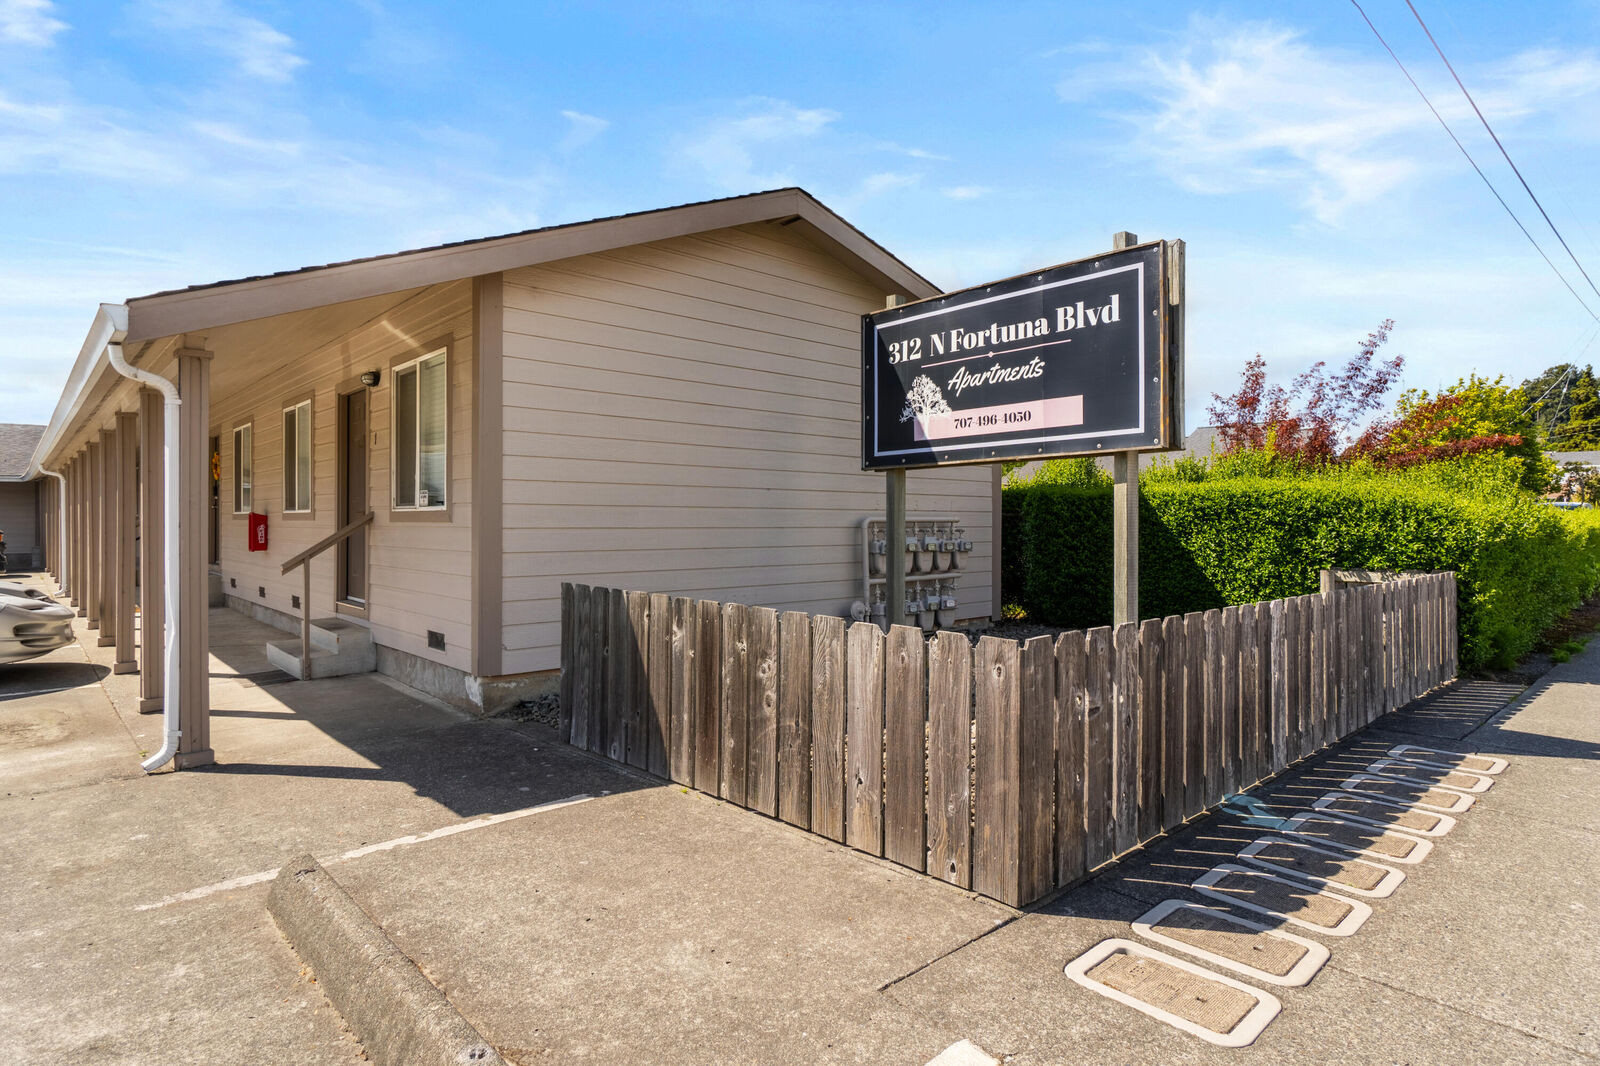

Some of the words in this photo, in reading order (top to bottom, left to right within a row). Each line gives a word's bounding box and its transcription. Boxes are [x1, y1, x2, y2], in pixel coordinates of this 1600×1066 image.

[889, 337, 922, 365] 312
[930, 331, 945, 357] N
[950, 316, 1050, 353] Fortuna
[1055, 293, 1121, 334] Blvd
[947, 355, 1046, 397] Apartments
[954, 409, 1032, 430] 707-496-4050
